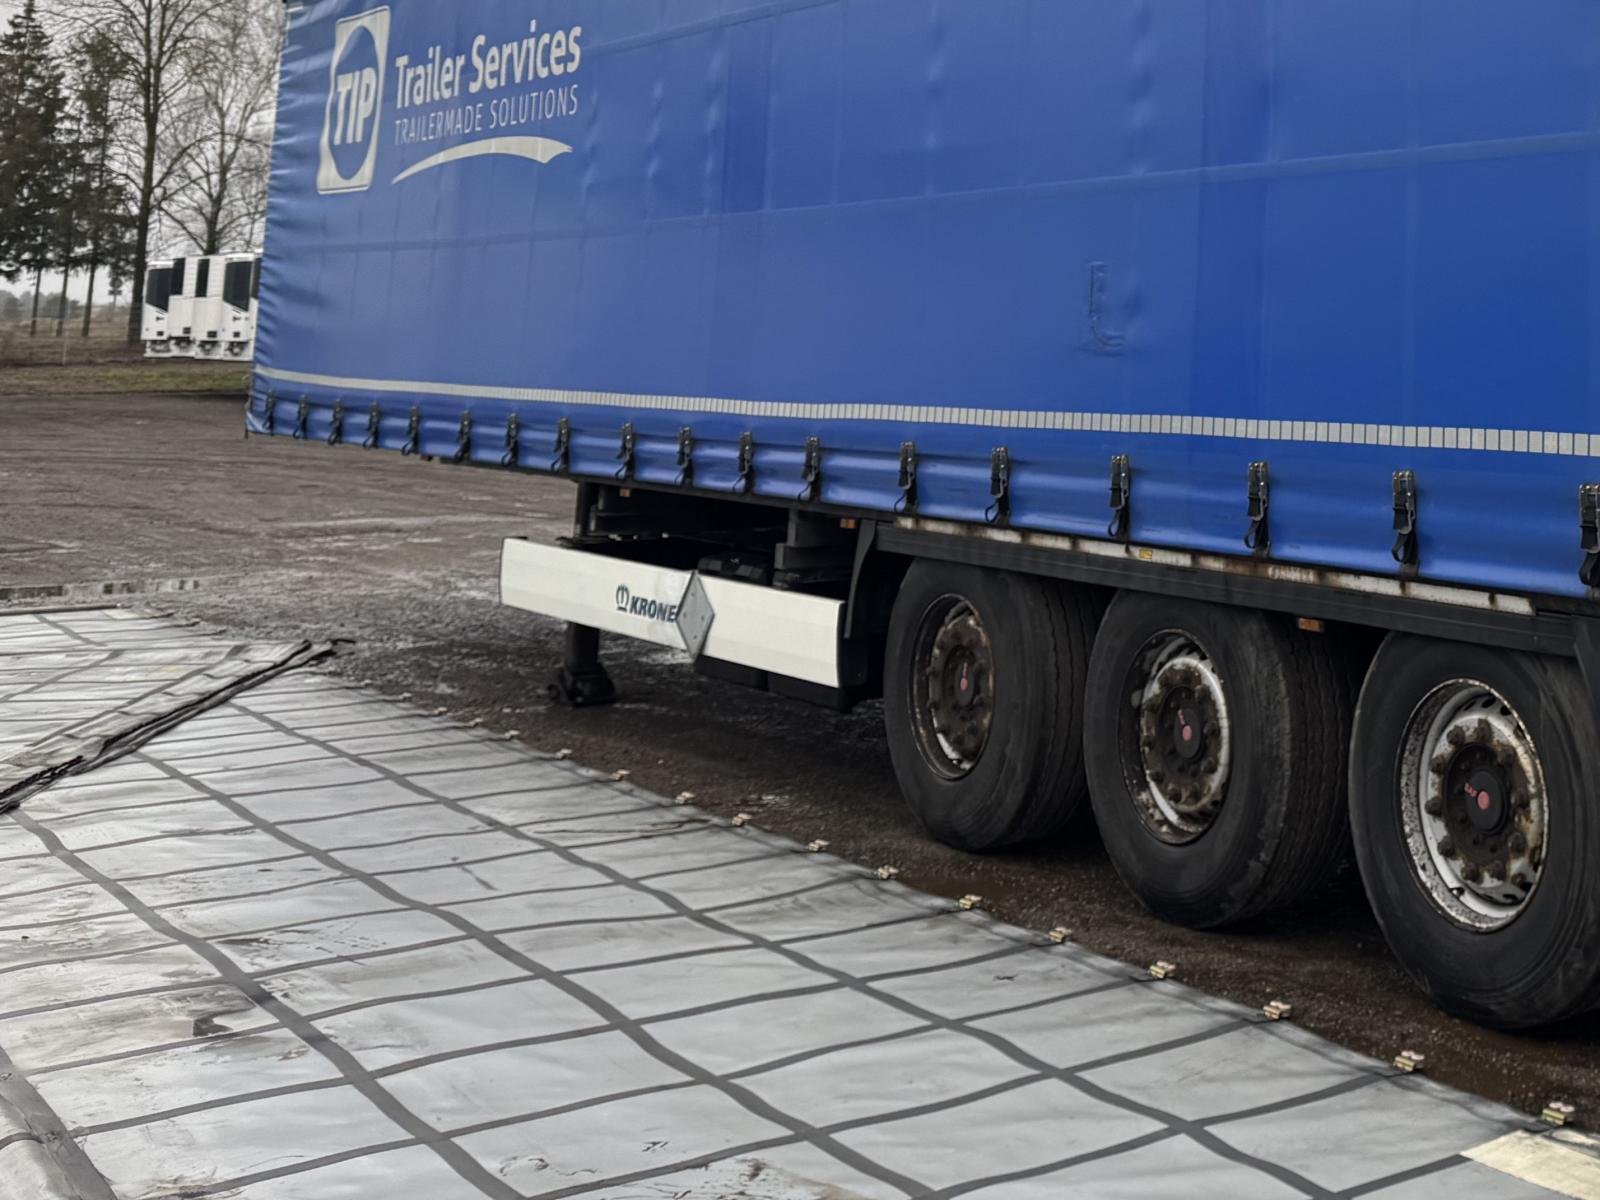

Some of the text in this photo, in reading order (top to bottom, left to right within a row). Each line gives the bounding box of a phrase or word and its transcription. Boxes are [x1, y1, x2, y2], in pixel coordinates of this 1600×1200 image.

[395, 19, 582, 109] Trailer Services
[333, 67, 377, 146] TIP
[395, 84, 579, 145] TRAILERMADE SOLUTIONS
[629, 596, 677, 623] KRONE
